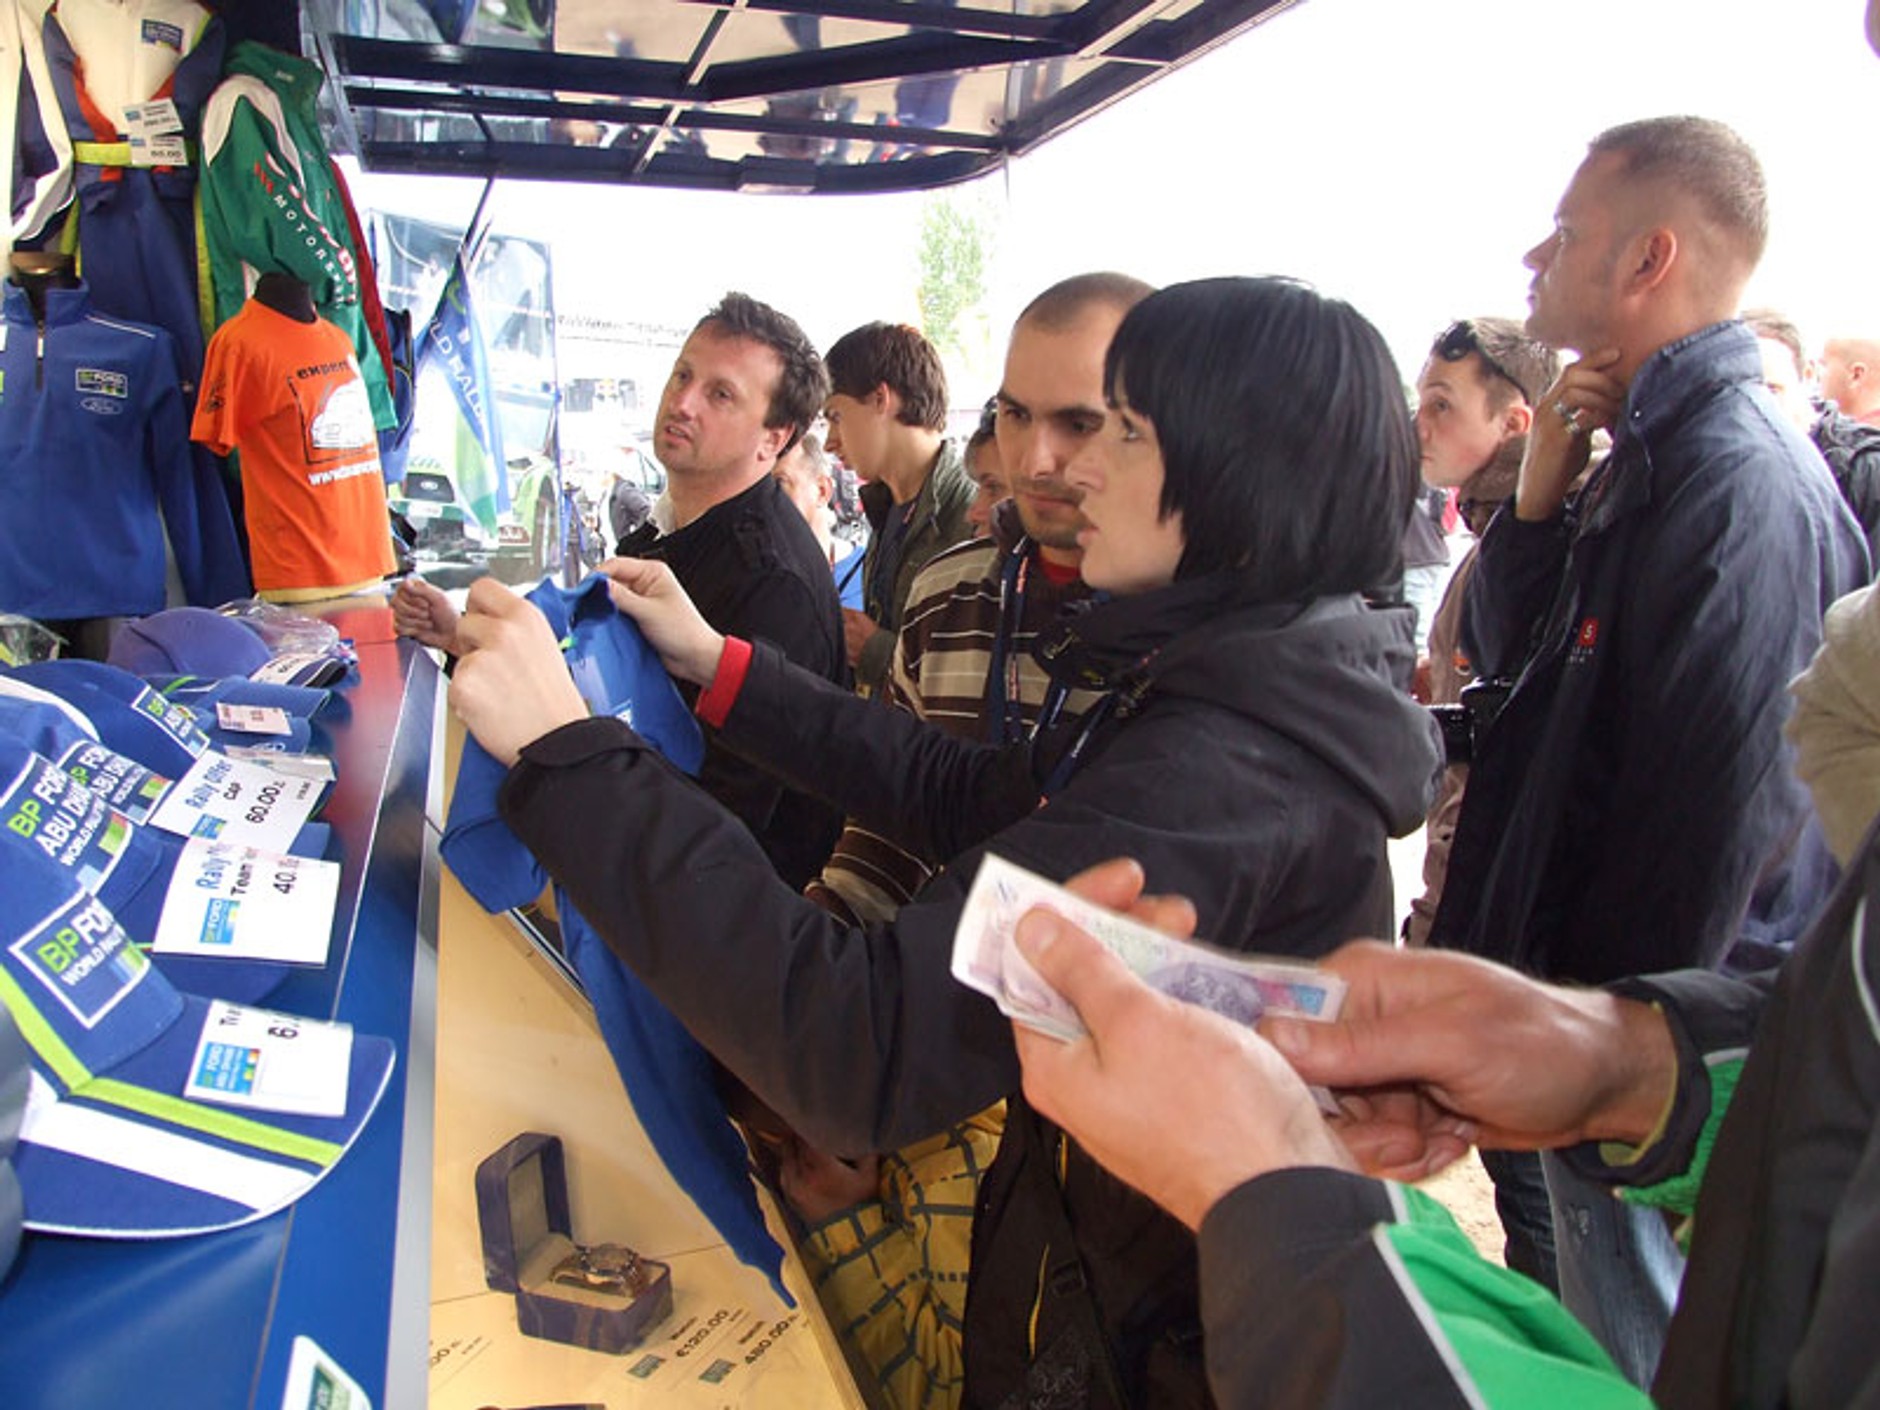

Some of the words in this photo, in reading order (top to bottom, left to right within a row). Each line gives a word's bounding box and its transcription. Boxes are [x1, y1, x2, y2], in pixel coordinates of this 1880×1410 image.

[7, 798, 41, 838] BP
[35, 810, 77, 857] ABU
[195, 857, 232, 889] Rally
[37, 928, 79, 973] BP
[61, 947, 106, 986] WORLD
